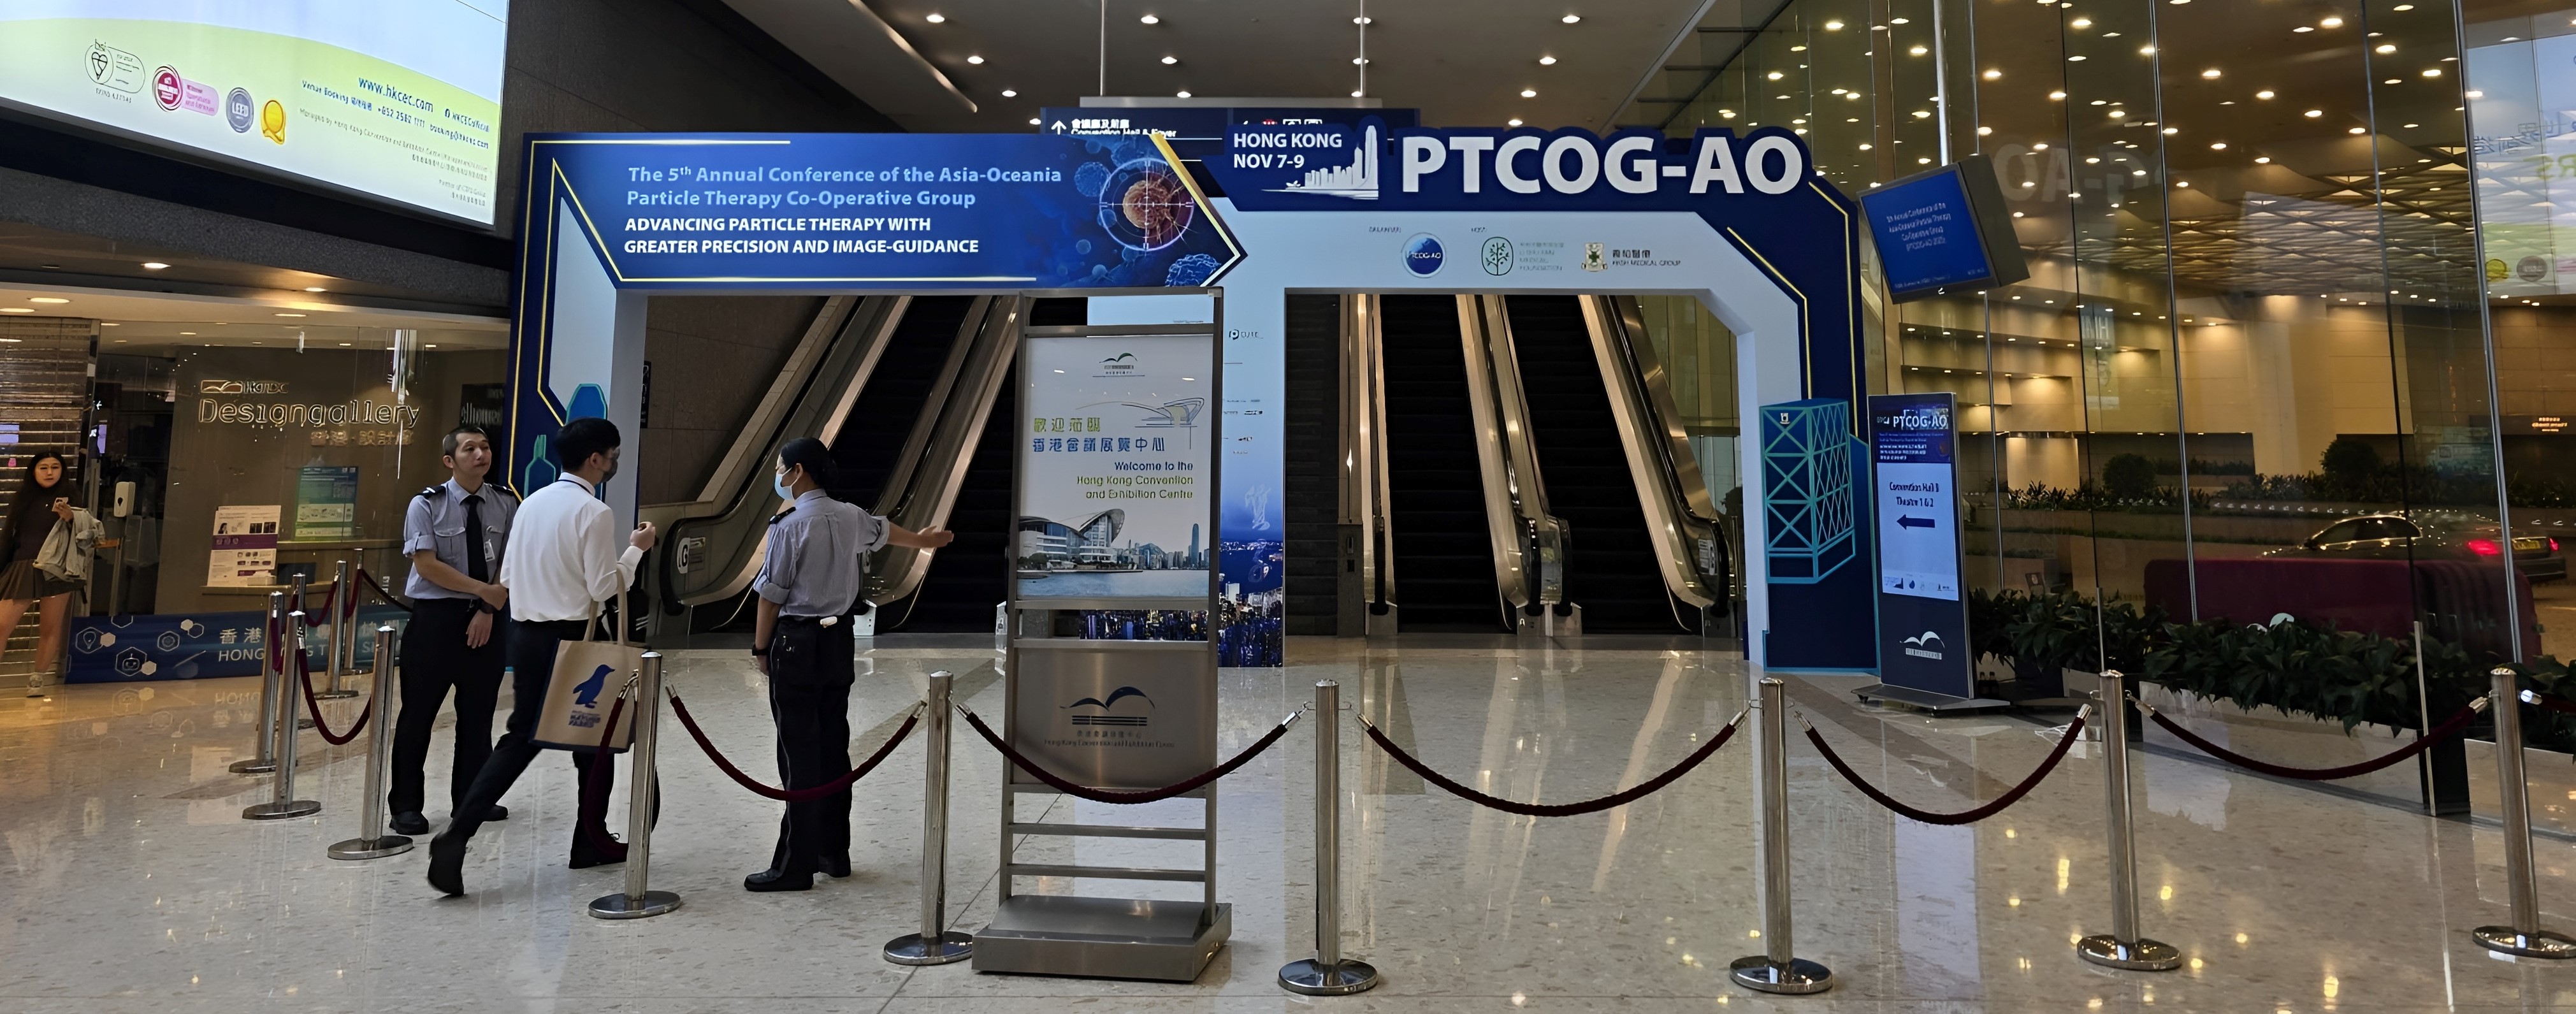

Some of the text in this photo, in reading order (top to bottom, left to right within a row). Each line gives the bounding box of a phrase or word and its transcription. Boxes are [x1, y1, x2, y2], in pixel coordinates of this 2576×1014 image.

[358, 77, 433, 113] www.hkcec.com
[1233, 132, 1343, 148] HONG KONG
[1233, 153, 1305, 170] NOV 7-9
[1402, 135, 1804, 196] PTCOG-AO
[628, 166, 1062, 182] The 5th Annual Conference of the Asia-Oceania
[627, 190, 976, 209] Particle Therapy Co-Operative Group
[625, 217, 931, 231] ADVANCING PARTICLE THERAPY WITH
[624, 239, 980, 254] GREATER PRECISION AND IMAGE-GUIDANCE
[198, 398, 421, 428] Designgallery
[1115, 461, 1193, 470] Welcome to the
[1076, 475, 1193, 486] Hong Kong Convention
[1086, 489, 1193, 499] and Exhibition Centre
[218, 649, 265, 662] HONG
